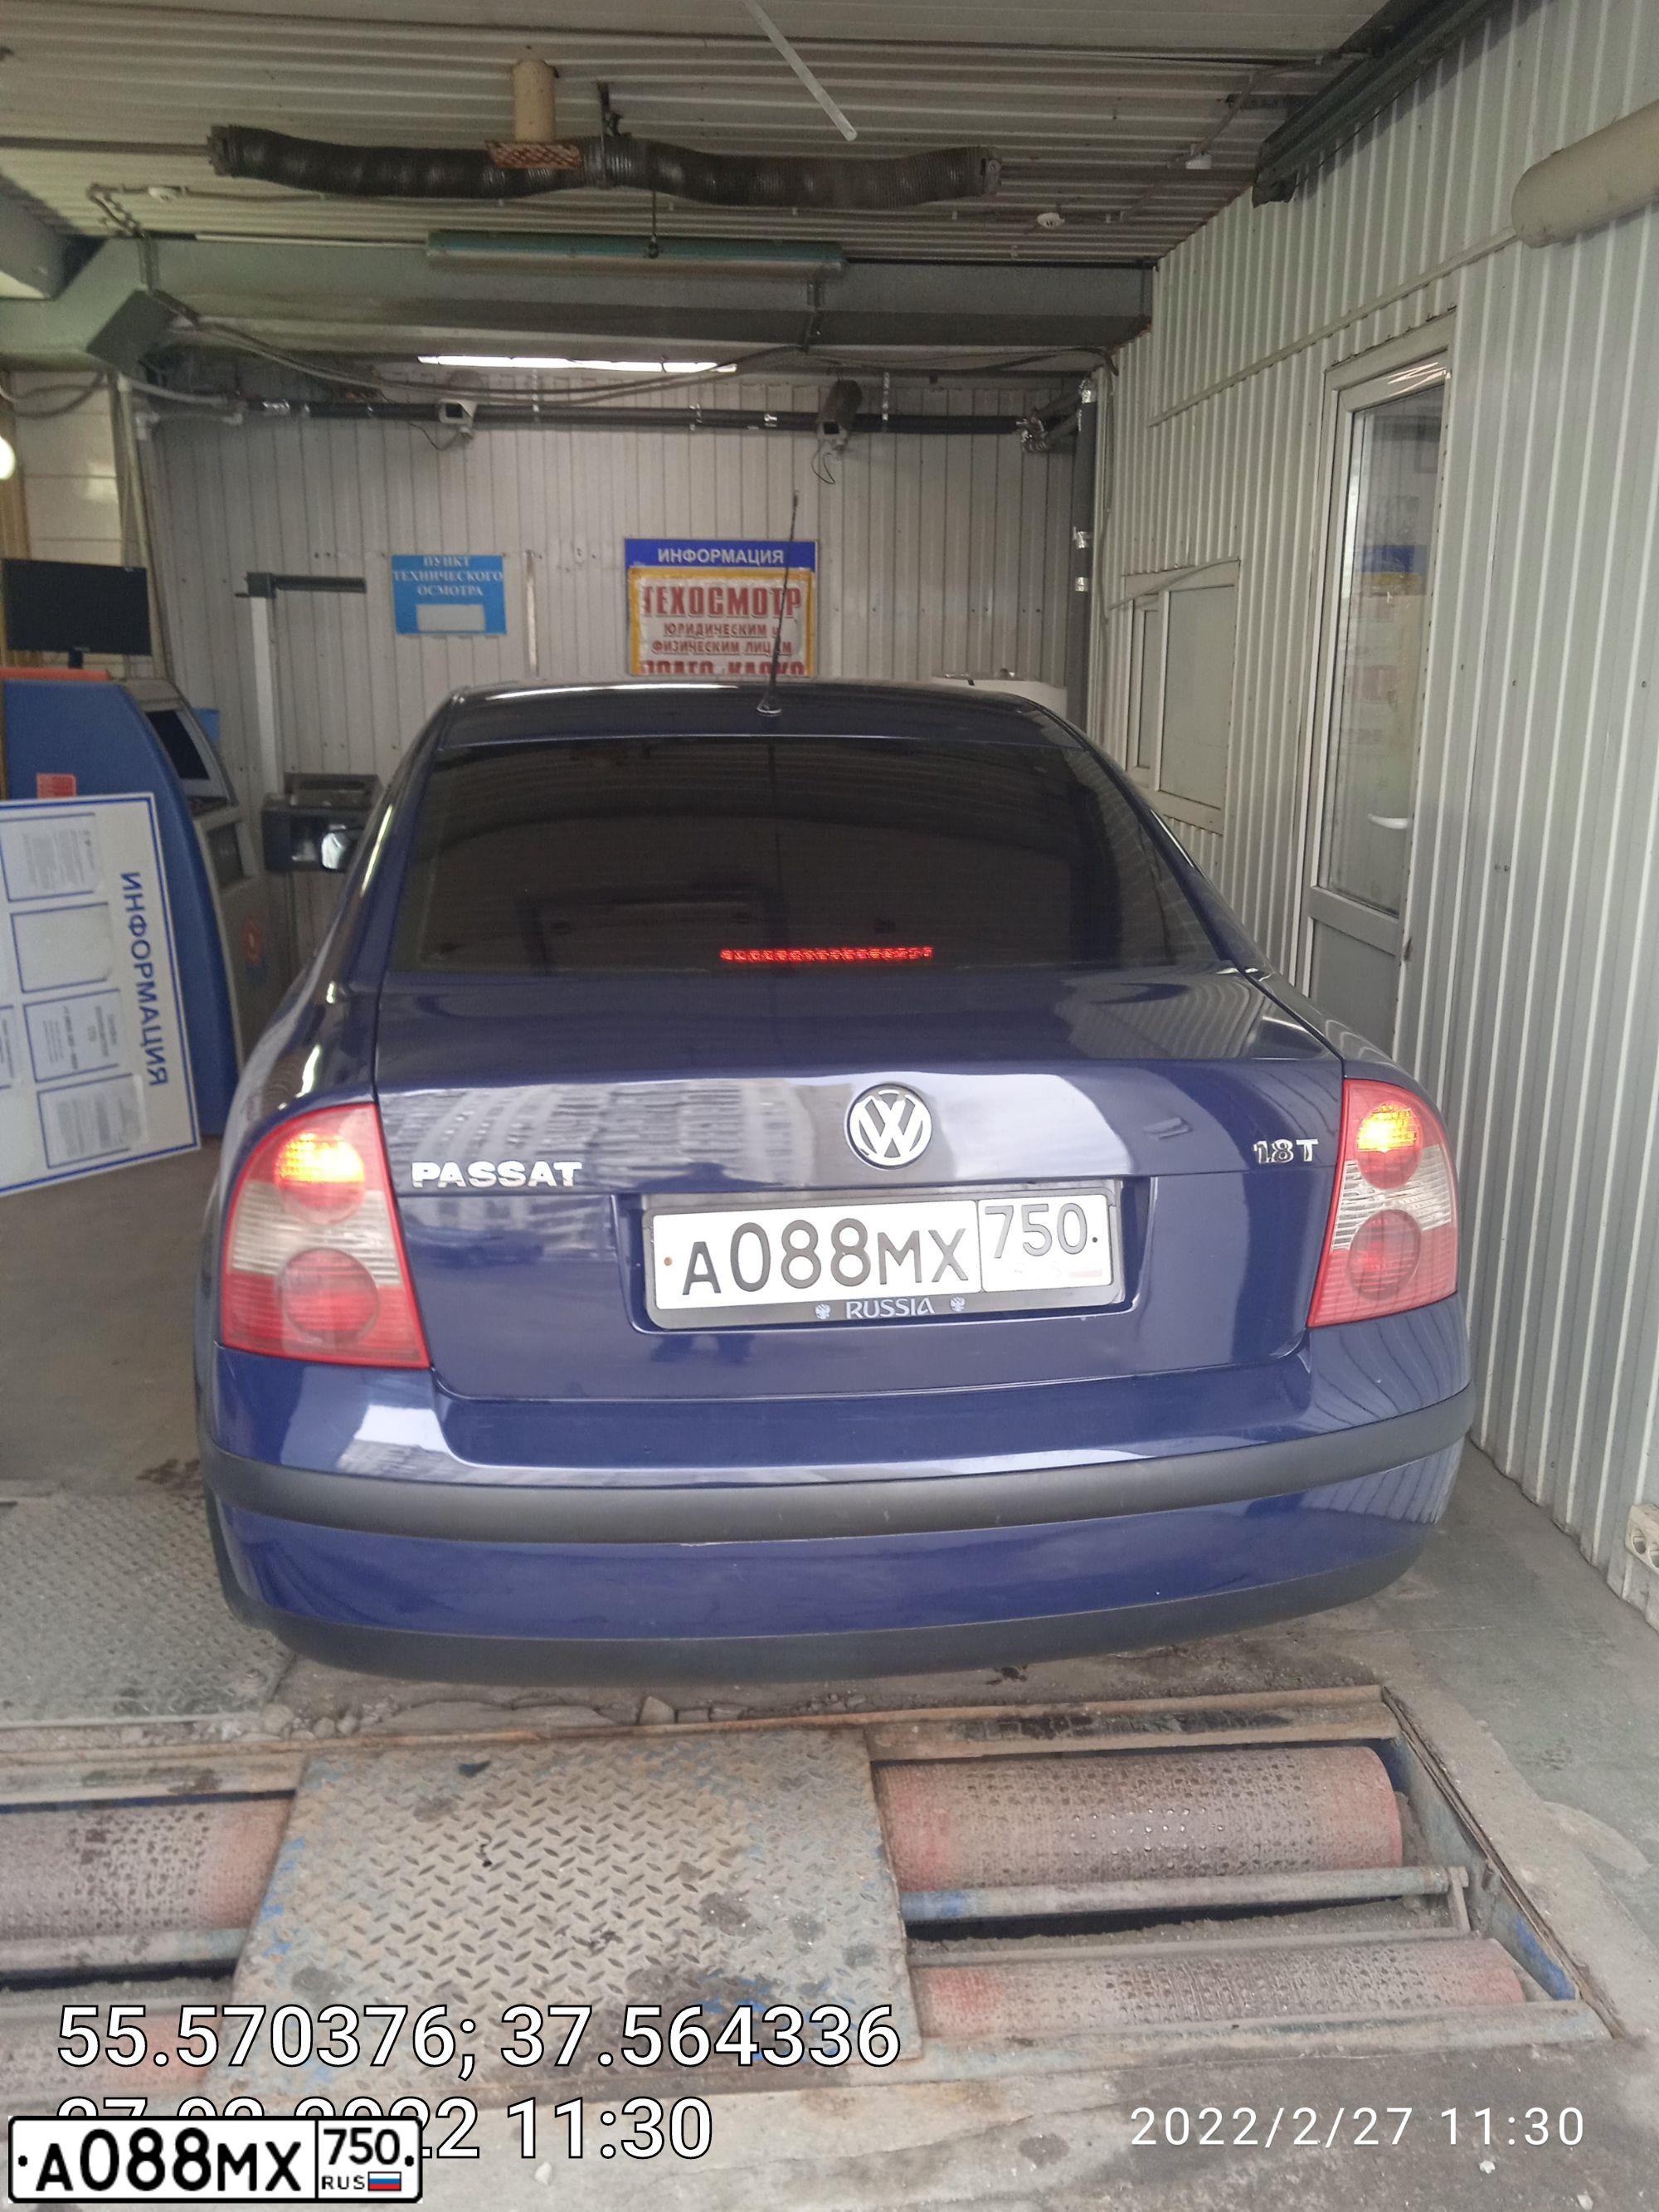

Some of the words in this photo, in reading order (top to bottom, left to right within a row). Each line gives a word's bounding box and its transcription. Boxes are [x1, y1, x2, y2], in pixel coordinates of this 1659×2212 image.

[423, 555, 470, 568] ПУНКТ
[658, 548, 785, 566] ИНФОРМАЦИЯ
[392, 569, 504, 582] ТЕХНИЧЕСКОГО
[416, 584, 484, 597] ОСМОТРА
[643, 586, 801, 618] ТЕХОСМОТР
[664, 622, 767, 639] ЮРИДИЧЕСКИМ
[652, 640, 741, 655] ФИЗИЧЕСКИМ
[743, 641, 793, 657] ЛИЦМ
[121, 872, 168, 1086] ИНФОРМАЦИЯ
[411, 1160, 582, 1188] PASSAT
[985, 1202, 1088, 1259] 750
[846, 1297, 936, 1320] RUSSIA
